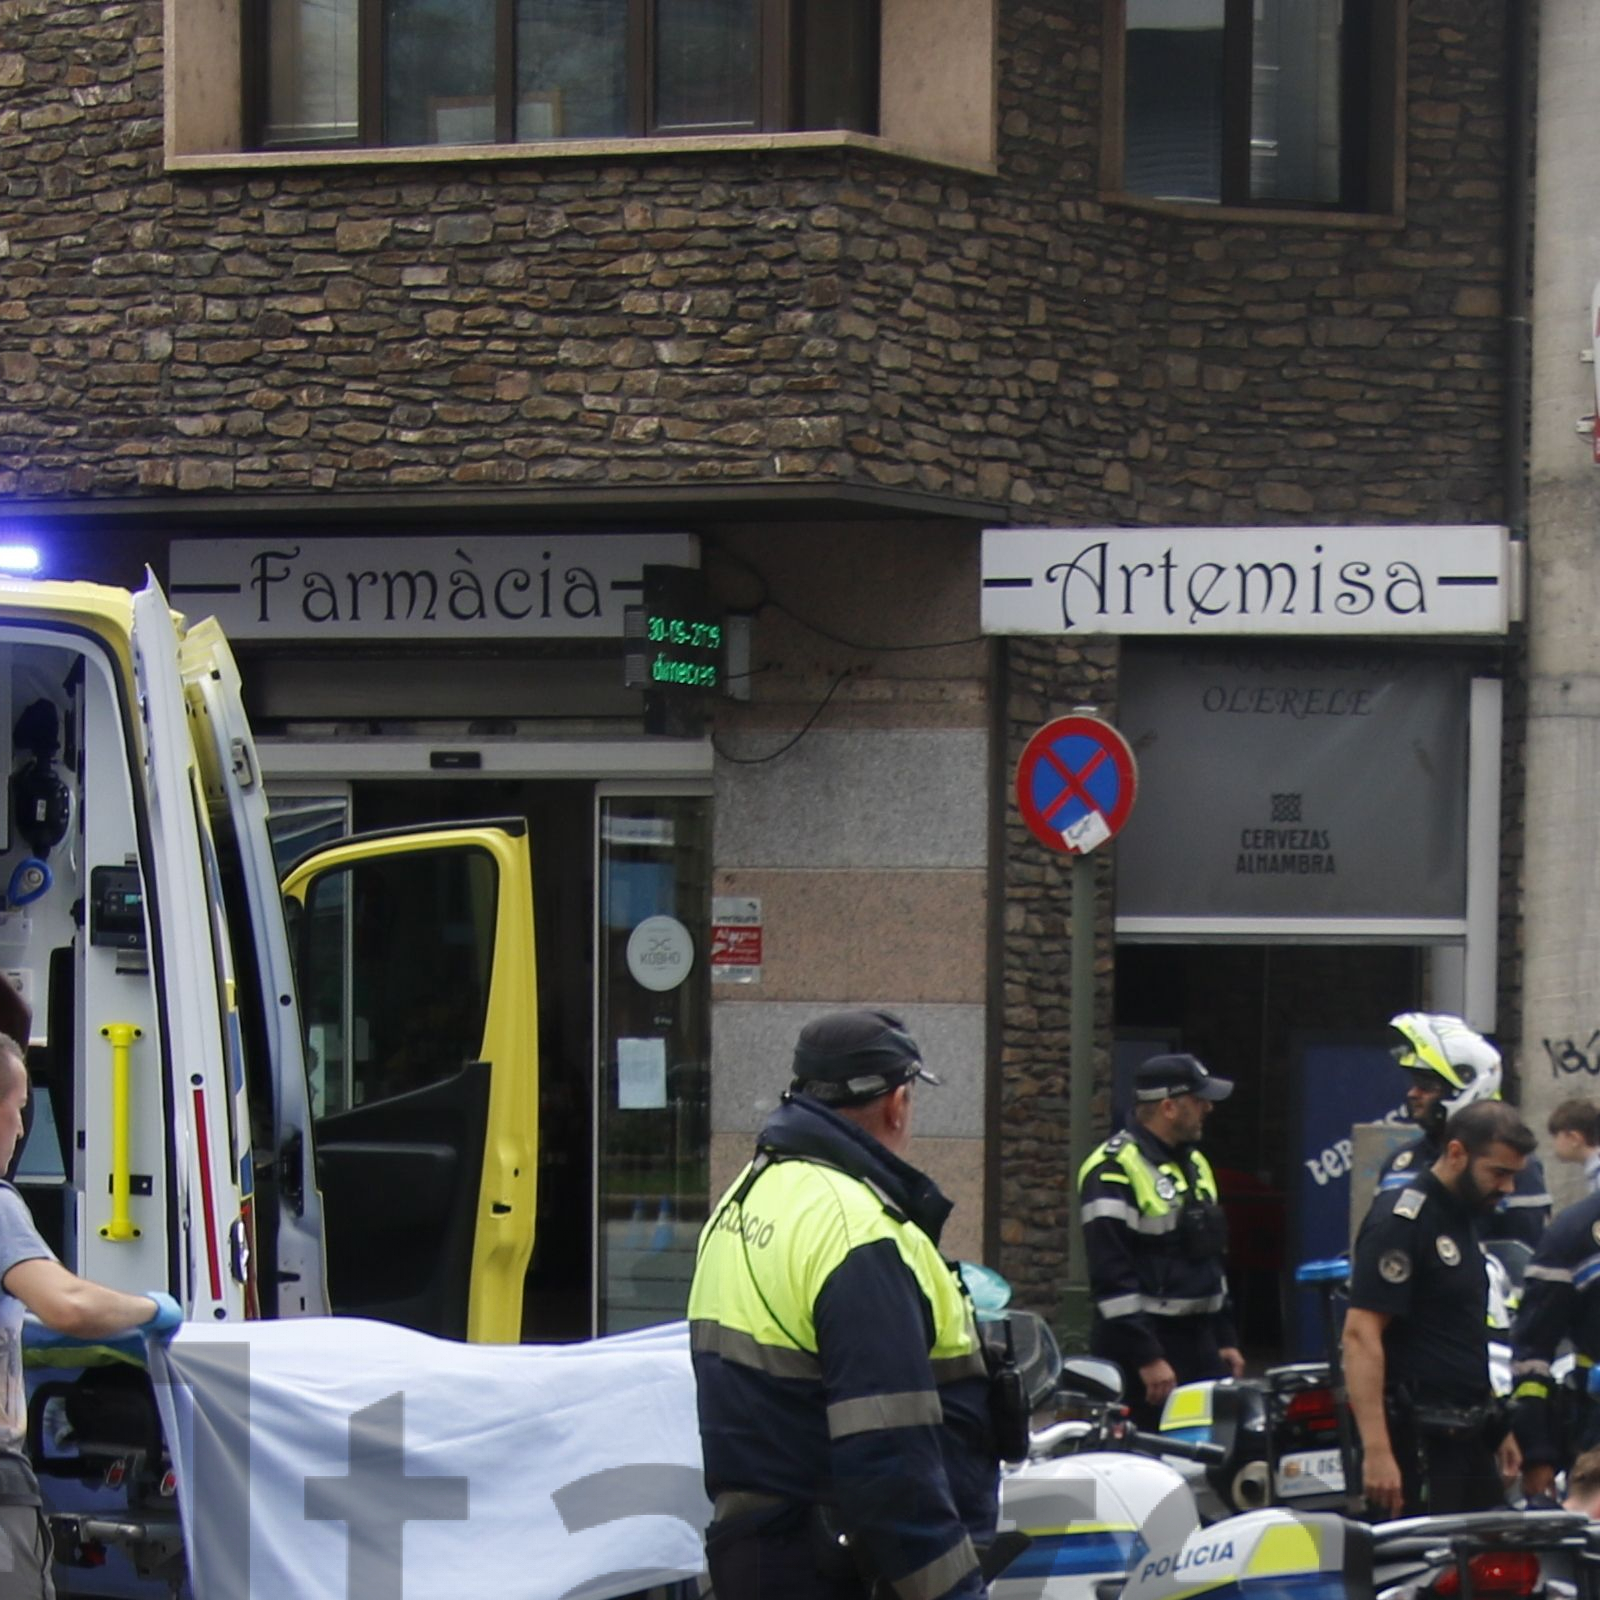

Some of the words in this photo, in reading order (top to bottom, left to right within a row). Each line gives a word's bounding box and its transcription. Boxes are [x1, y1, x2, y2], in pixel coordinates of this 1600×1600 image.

[251, 545, 603, 623] Farmàcia
[1045, 541, 1428, 630] Artemisa
[1202, 684, 1374, 720] OLERELE
[1241, 827, 1331, 851] CERVEZAS
[1236, 853, 1336, 875] ALHAMBRA
[1140, 1541, 1235, 1583] POLICIA
